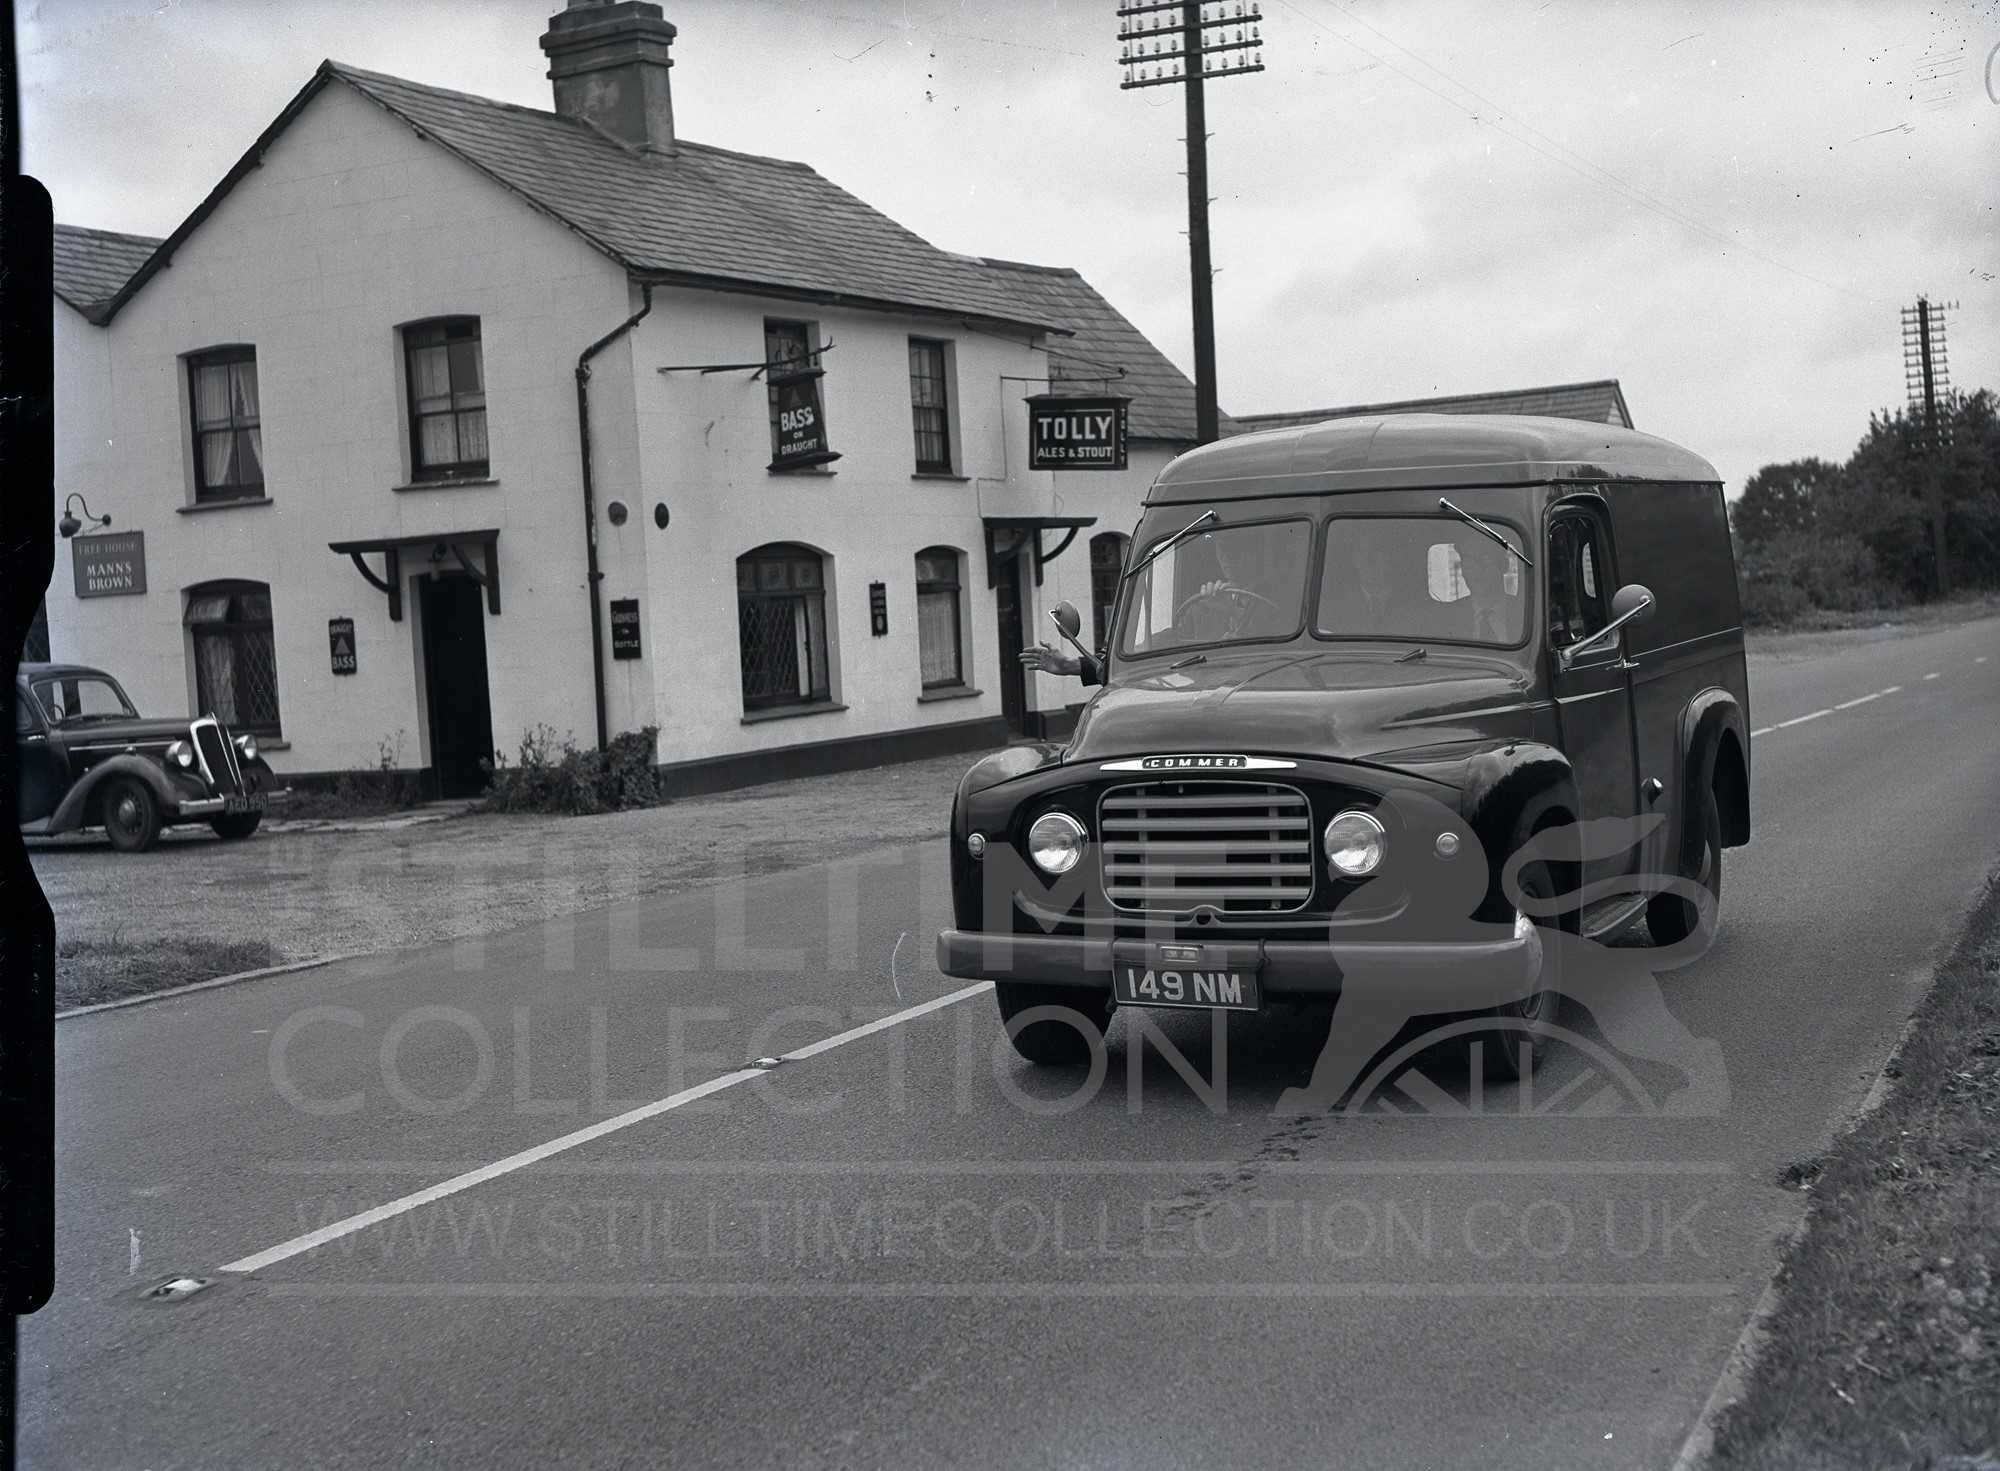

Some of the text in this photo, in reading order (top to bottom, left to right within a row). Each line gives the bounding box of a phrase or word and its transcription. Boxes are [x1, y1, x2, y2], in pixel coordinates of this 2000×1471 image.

[781, 406, 815, 432] BASS
[1038, 416, 1112, 440] TOLLY
[780, 438, 817, 456] DRAUGHT
[1037, 446, 1113, 459] ALES & STOUT
[88, 575, 133, 591] BROWN
[332, 655, 355, 670] BASS
[1150, 758, 1239, 768] COMMER
[1127, 968, 1243, 1004] 149 NM
